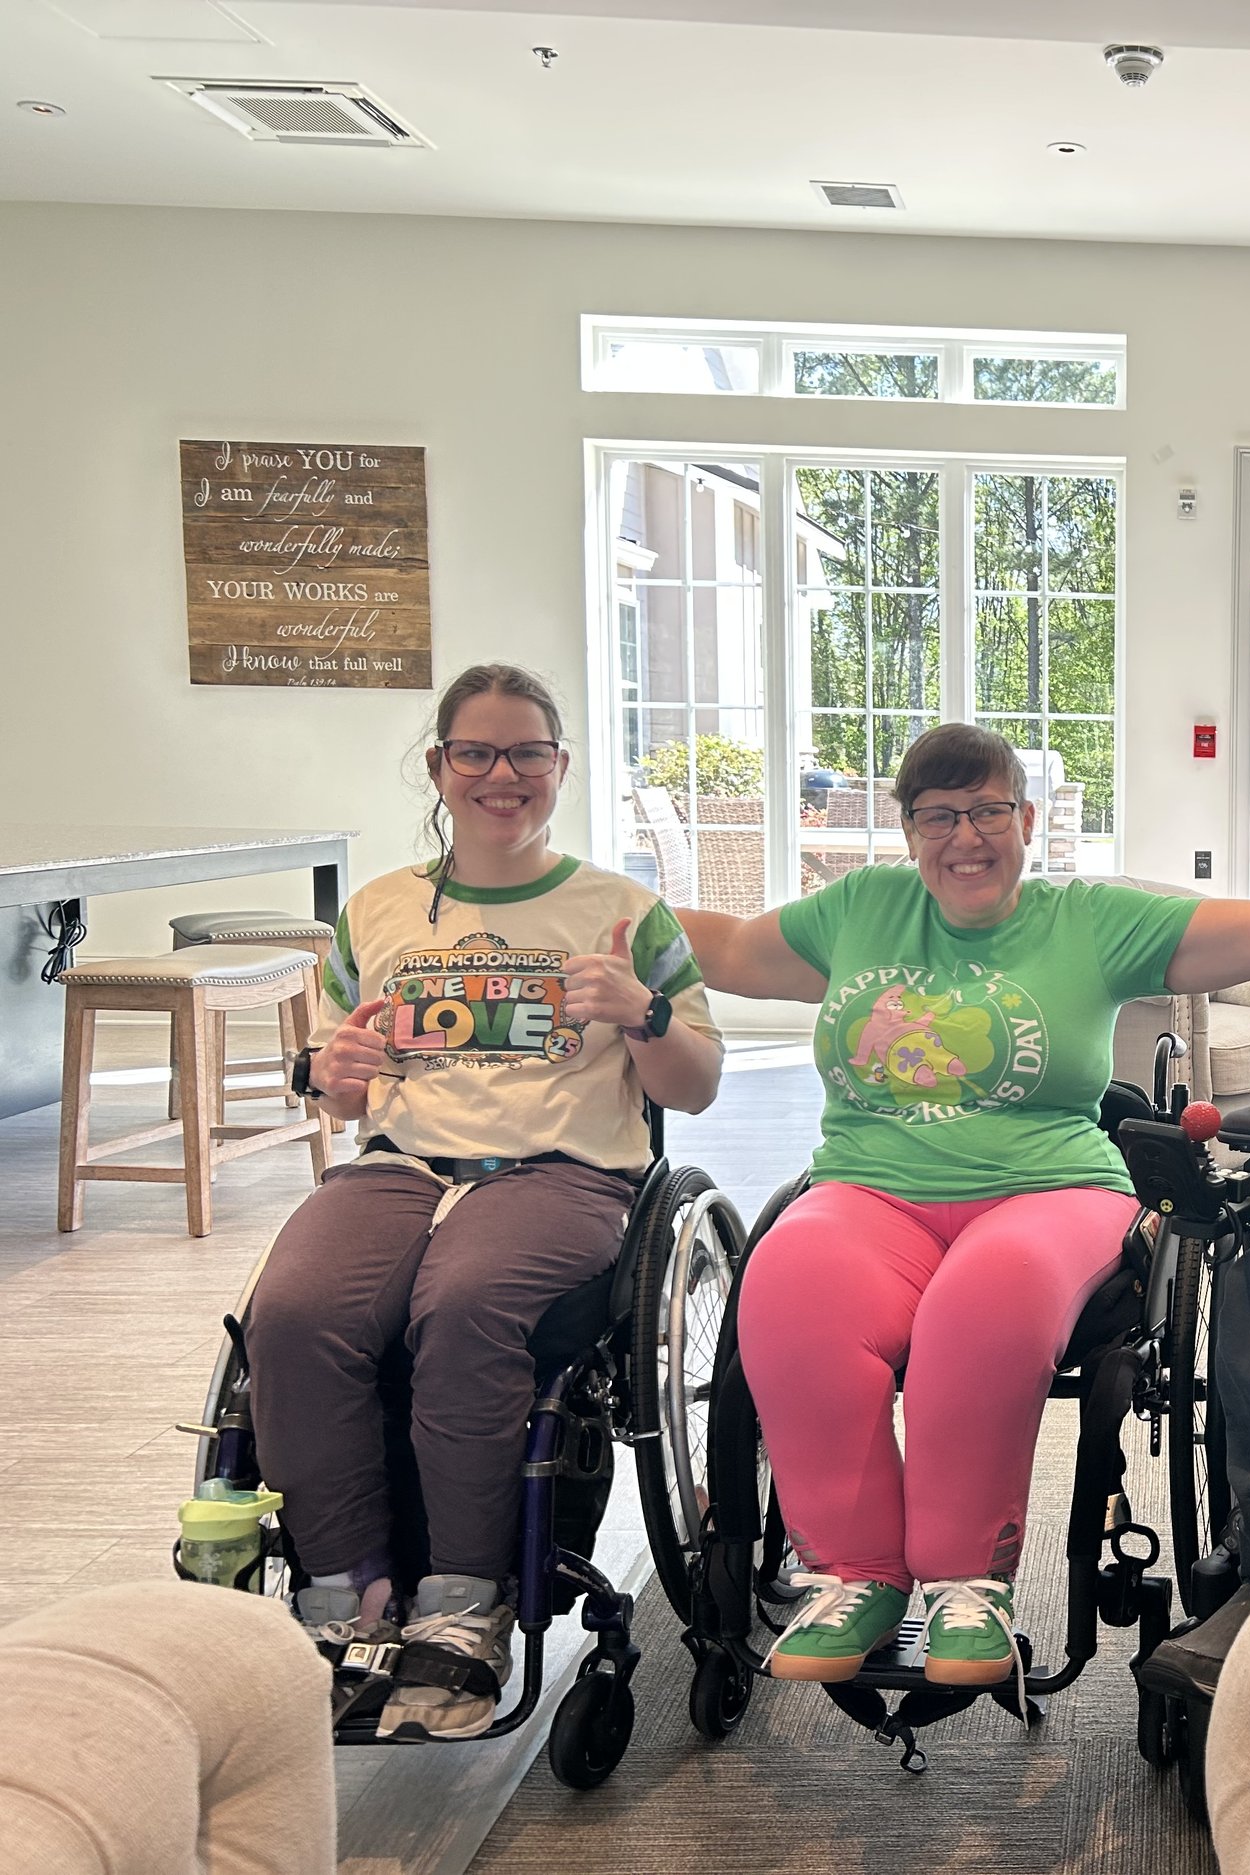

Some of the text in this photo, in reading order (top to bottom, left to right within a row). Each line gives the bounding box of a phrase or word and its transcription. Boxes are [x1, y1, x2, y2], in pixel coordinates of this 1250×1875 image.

[215, 441, 381, 473] I praise YOU for
[194, 475, 373, 522] I am fearfully and
[239, 524, 401, 575] wonderfully made;
[207, 580, 399, 602] YOUR WORKS are
[243, 646, 302, 671] know
[308, 657, 339, 671] that
[343, 657, 368, 671] full
[373, 657, 403, 672] well
[400, 953, 443, 970] PAUL
[401, 976, 548, 1001] ONE BIG
[823, 967, 923, 1026] HAPPY
[393, 999, 555, 1050] LOVE
[1009, 1016, 1044, 1076] DAY
